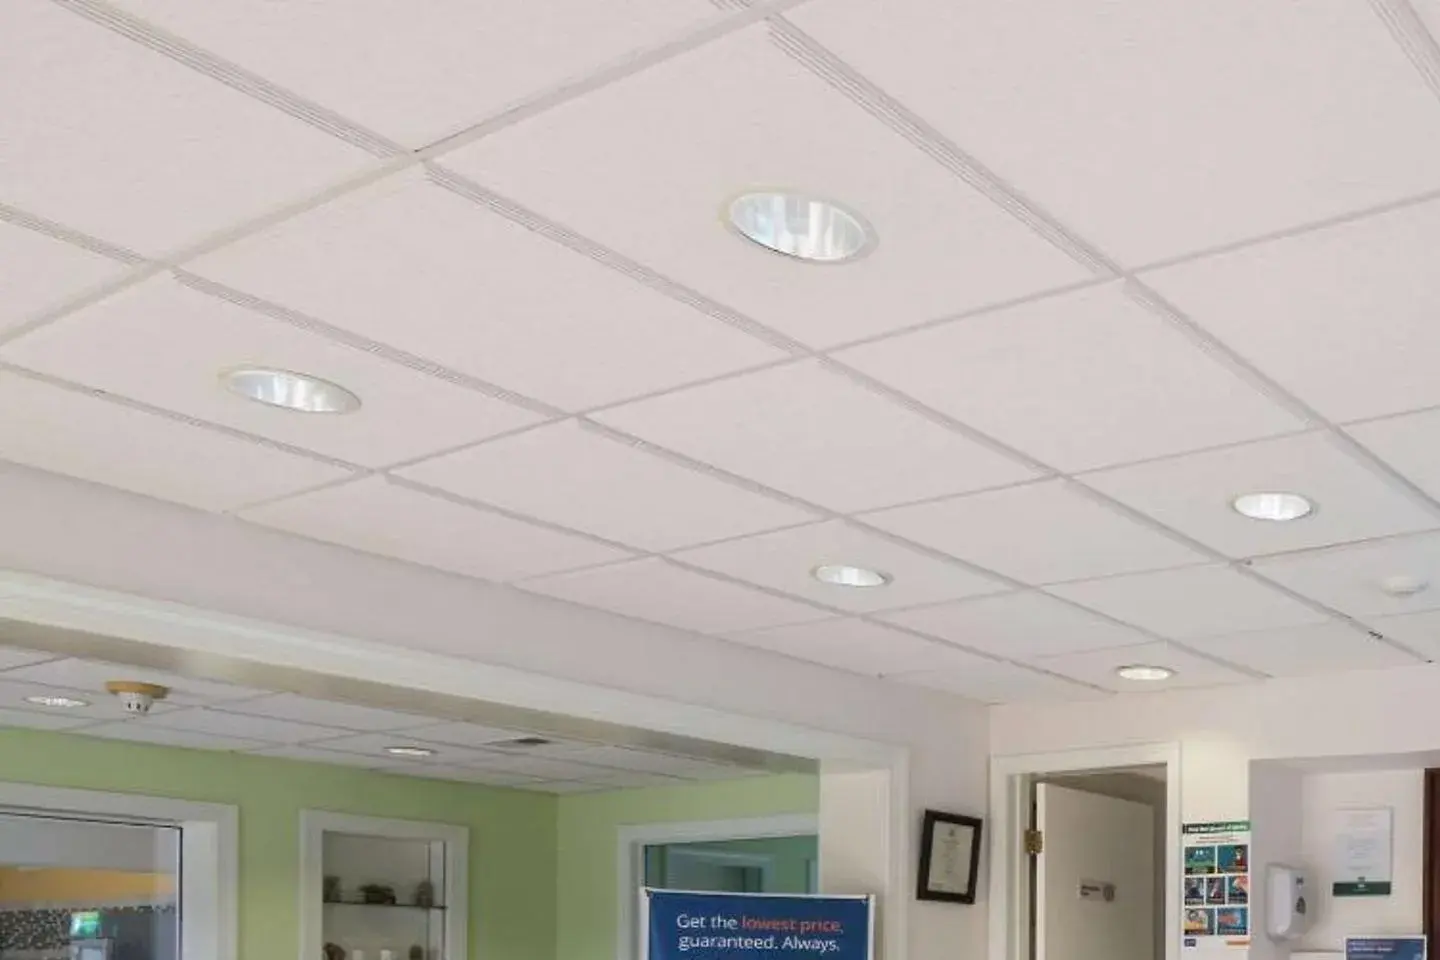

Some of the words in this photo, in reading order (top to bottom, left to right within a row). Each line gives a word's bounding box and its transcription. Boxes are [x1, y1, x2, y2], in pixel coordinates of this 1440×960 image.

[676, 913, 706, 929] Get
[711, 914, 739, 930] the
[742, 915, 795, 930] lowest
[800, 917, 844, 934] price,
[678, 934, 779, 951] guaranteed.
[781, 935, 841, 956] Always.
